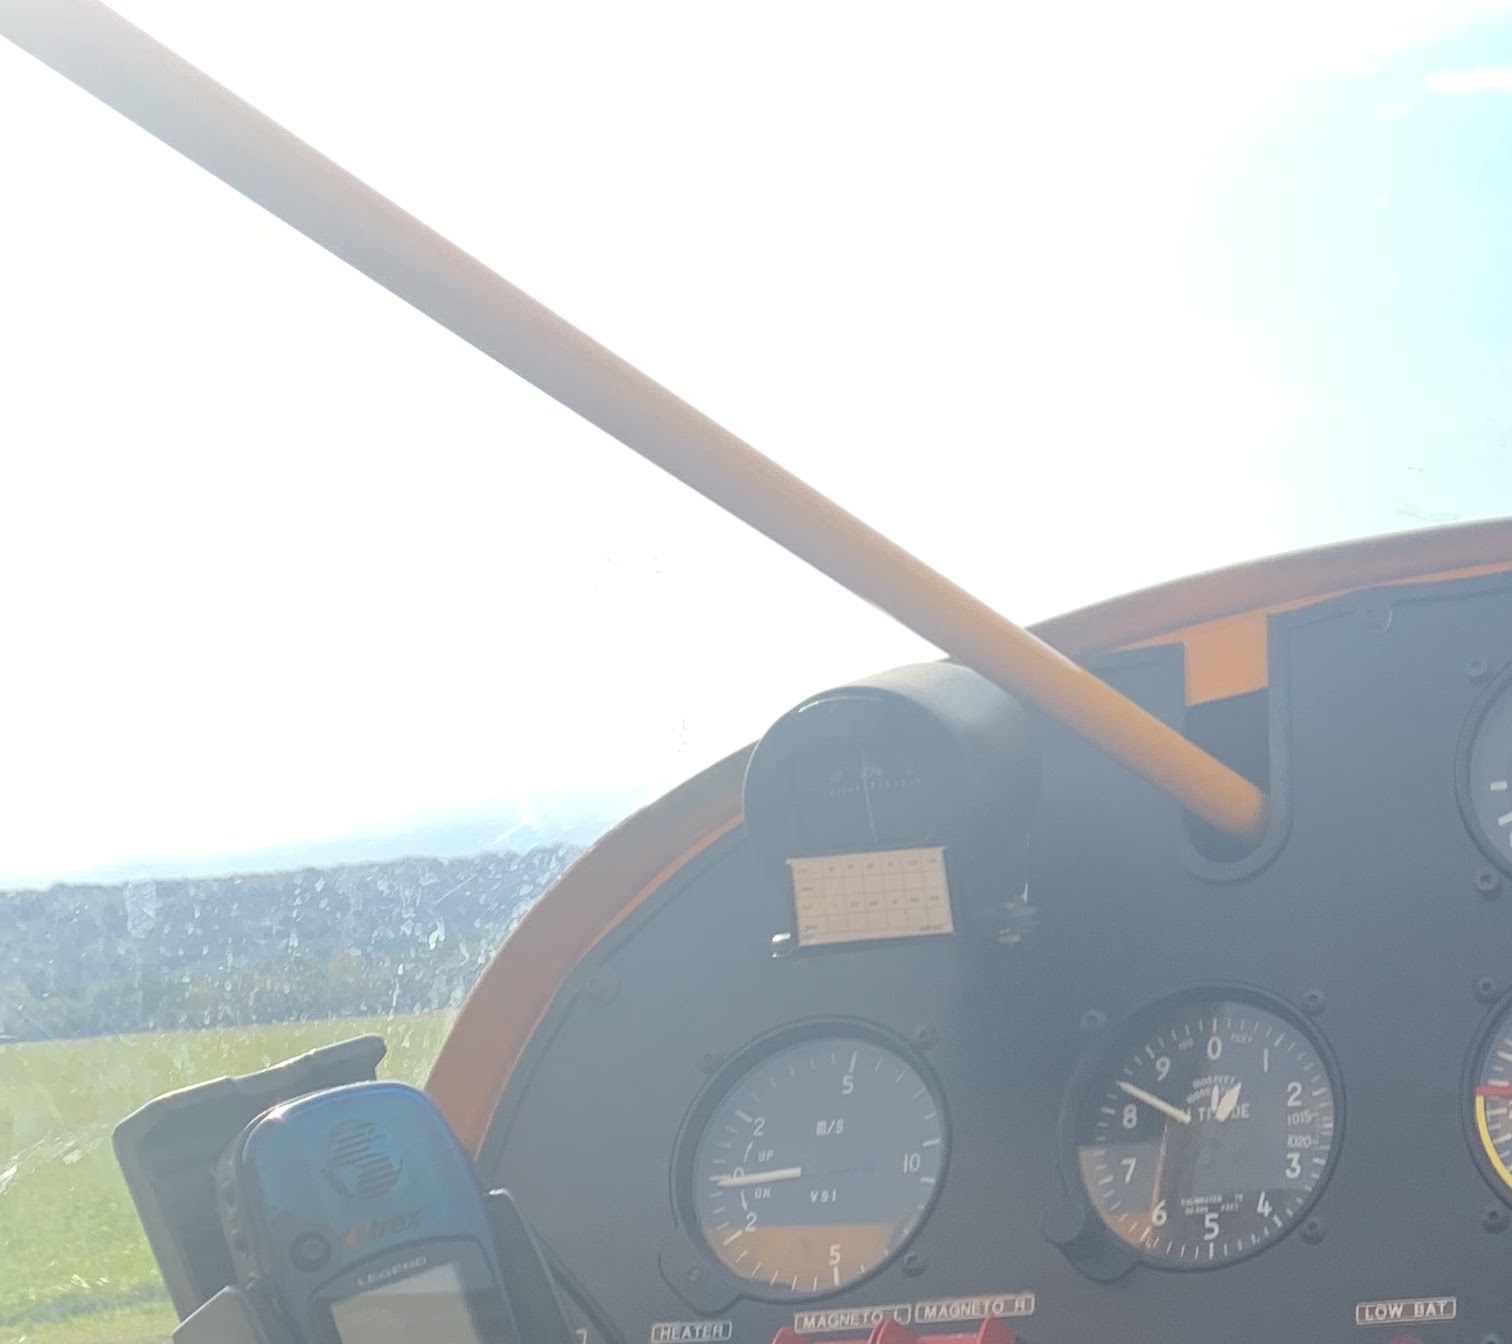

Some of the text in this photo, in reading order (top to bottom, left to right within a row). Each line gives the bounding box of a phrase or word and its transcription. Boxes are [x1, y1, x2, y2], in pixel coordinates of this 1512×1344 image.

[1207, 1036, 1222, 1060] 0
[1155, 1057, 1171, 1081] 9
[841, 1075, 854, 1095] 5
[1287, 1081, 1302, 1106] 2
[753, 1117, 765, 1136] 2
[1123, 1104, 1137, 1128] 8
[903, 1153, 921, 1173] 10
[1121, 1158, 1136, 1184] 7
[1285, 1152, 1301, 1178] 3
[1152, 1200, 1167, 1226] 6
[1257, 1191, 1272, 1217] 4
[745, 1212, 757, 1232] 2
[1203, 1212, 1220, 1240] 5
[829, 1244, 841, 1266] 5
[802, 1310, 883, 1329] MAGNETO
[924, 1300, 1003, 1319] MAGNETO
[1365, 1300, 1447, 1321] LOW BAT
[660, 1324, 724, 1341] HEATER
